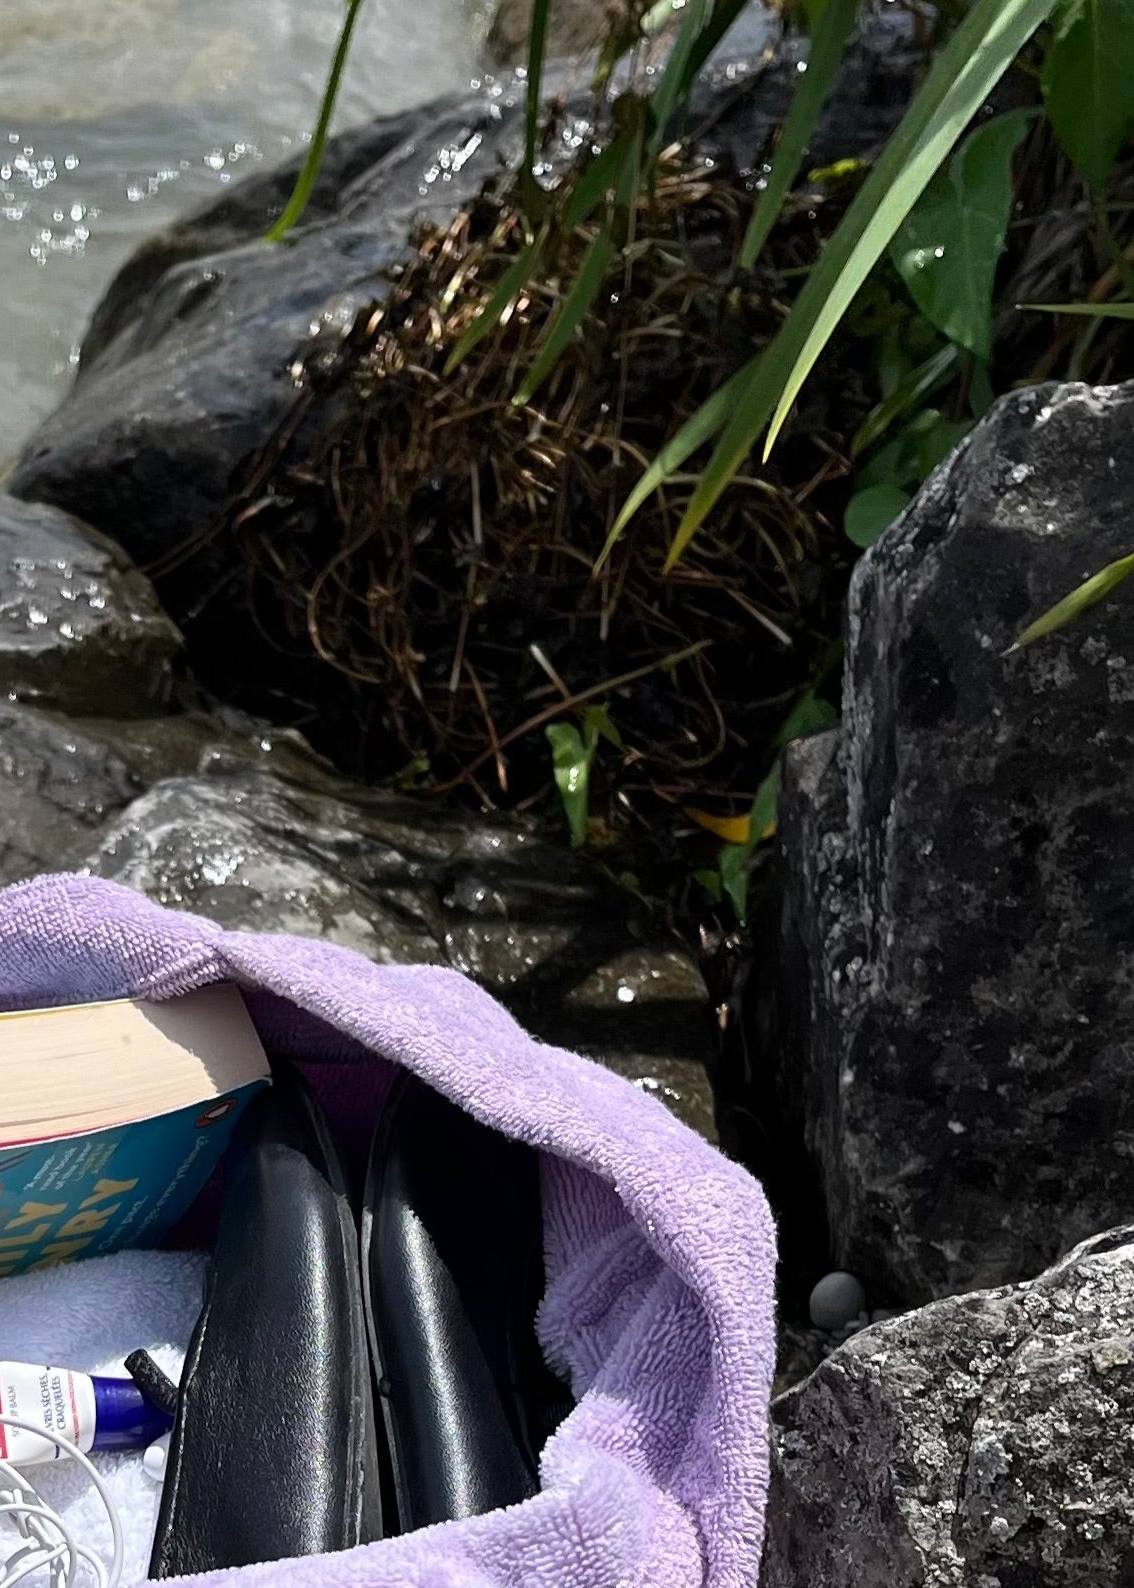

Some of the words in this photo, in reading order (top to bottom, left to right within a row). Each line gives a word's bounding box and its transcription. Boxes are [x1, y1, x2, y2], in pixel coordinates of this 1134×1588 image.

[26, 1178, 140, 1268] NRY
[6, 1385, 18, 1408] BALM
[51, 1376, 66, 1430] CRAQUELÉES
[43, 1409, 55, 1432] VRES
